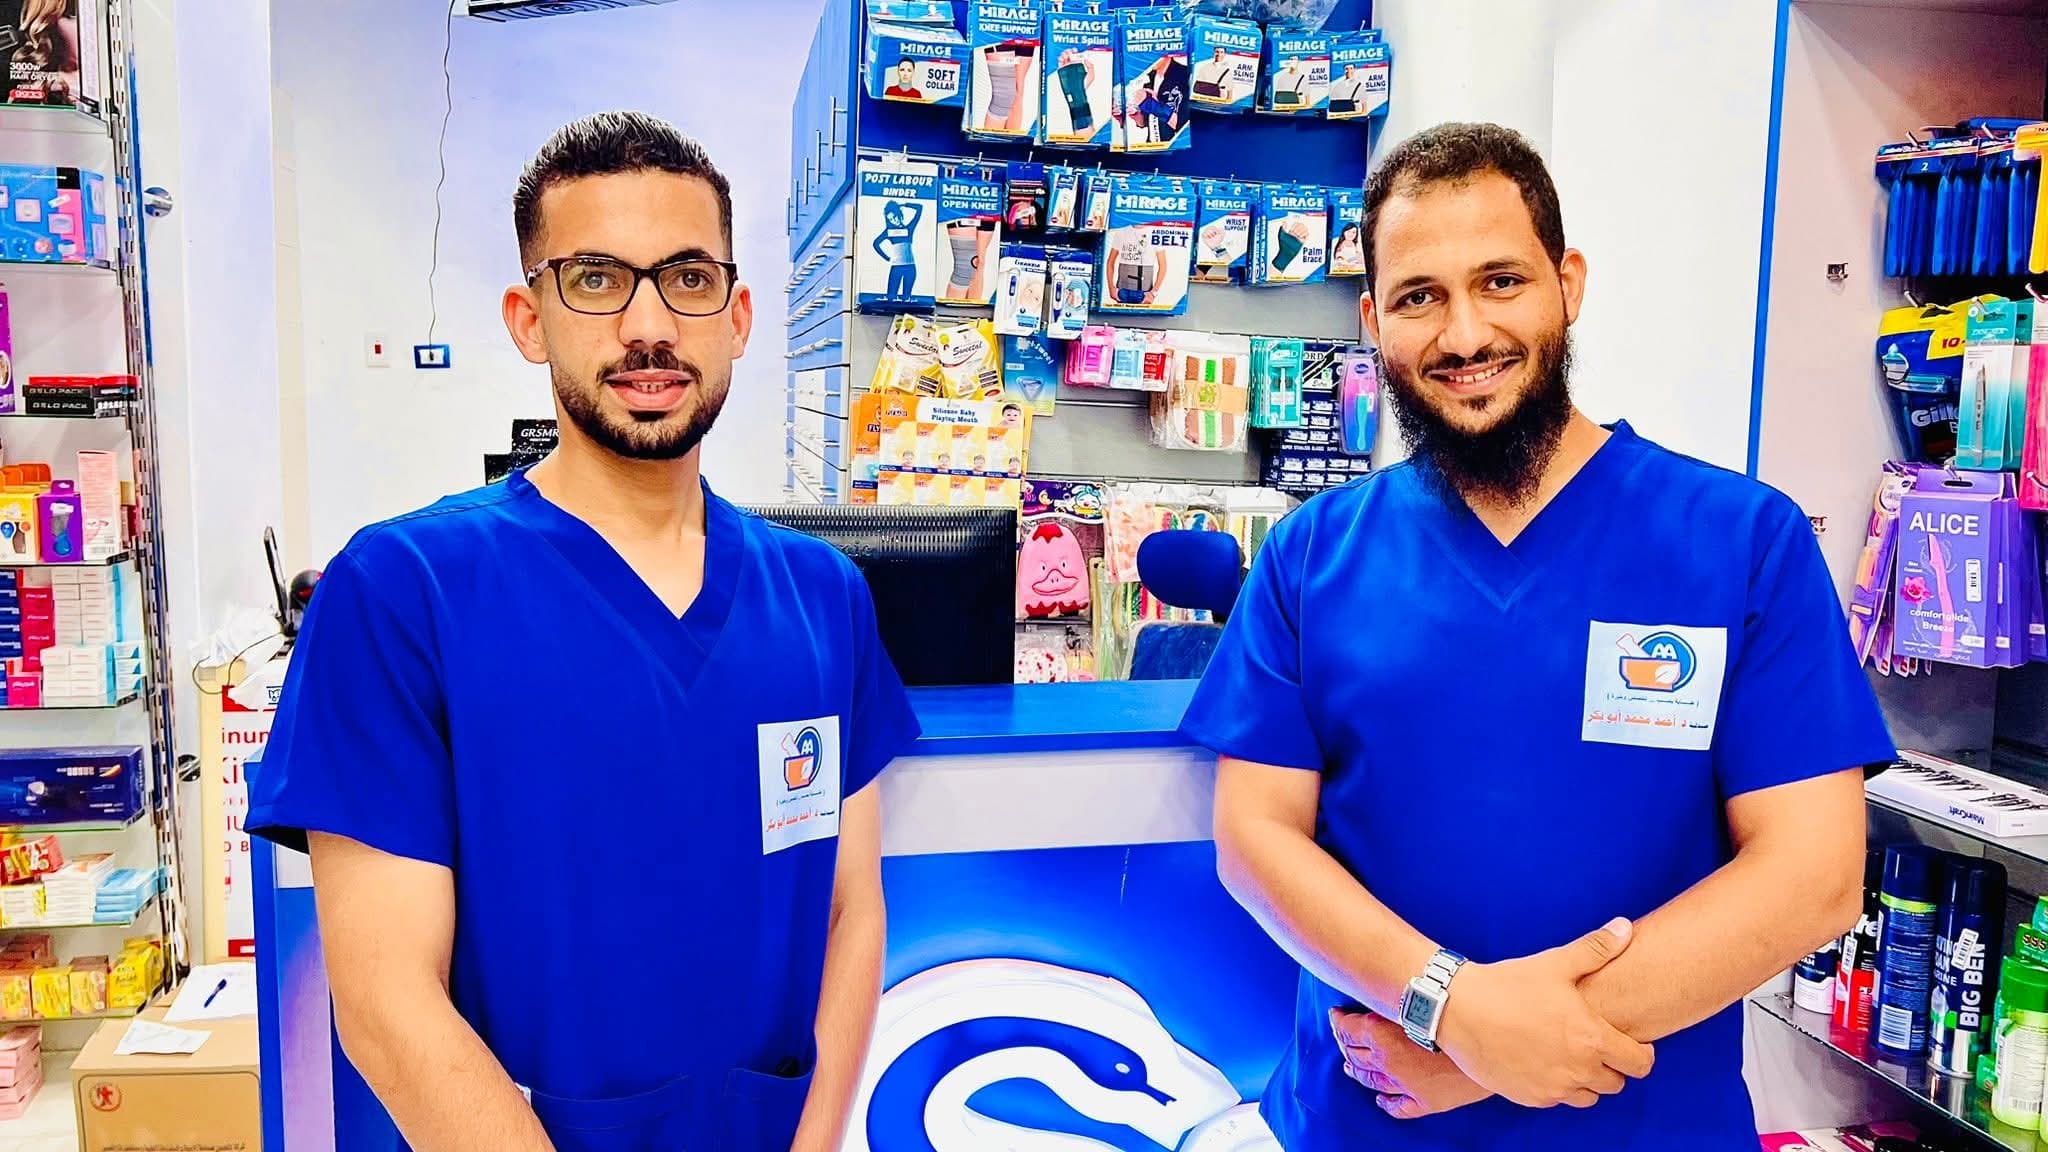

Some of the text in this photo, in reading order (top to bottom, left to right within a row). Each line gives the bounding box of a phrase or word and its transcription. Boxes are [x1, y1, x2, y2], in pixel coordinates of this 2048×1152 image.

[978, 23, 1036, 36] KNEE SUPPORT
[1053, 33, 1110, 47] Wrist Splint
[1126, 41, 1185, 53] WRIST SPLINT
[1236, 63, 1254, 72] ARM
[1310, 66, 1327, 75] ARM
[927, 67, 956, 81] SOFT
[1233, 69, 1255, 80] SLING
[1308, 73, 1329, 82] SLING
[1368, 73, 1385, 82] ARM
[925, 80, 956, 92] COLLAR
[1365, 80, 1387, 90] SLING
[865, 173, 933, 187] POST LABOUR
[882, 187, 917, 199] BINDER
[942, 200, 998, 211] OPEN KNEE
[1225, 218, 1247, 226] WRIST
[1151, 229, 1189, 237] ABDOMINAL
[1151, 235, 1189, 248] BELT
[1302, 246, 1323, 257] Palm
[1302, 255, 1323, 263] Brace
[1302, 351, 1324, 360] ORD
[1911, 402, 1960, 427] Gill
[1909, 511, 1979, 536] ALICE
[1958, 943, 1986, 1028] BIG BEN
